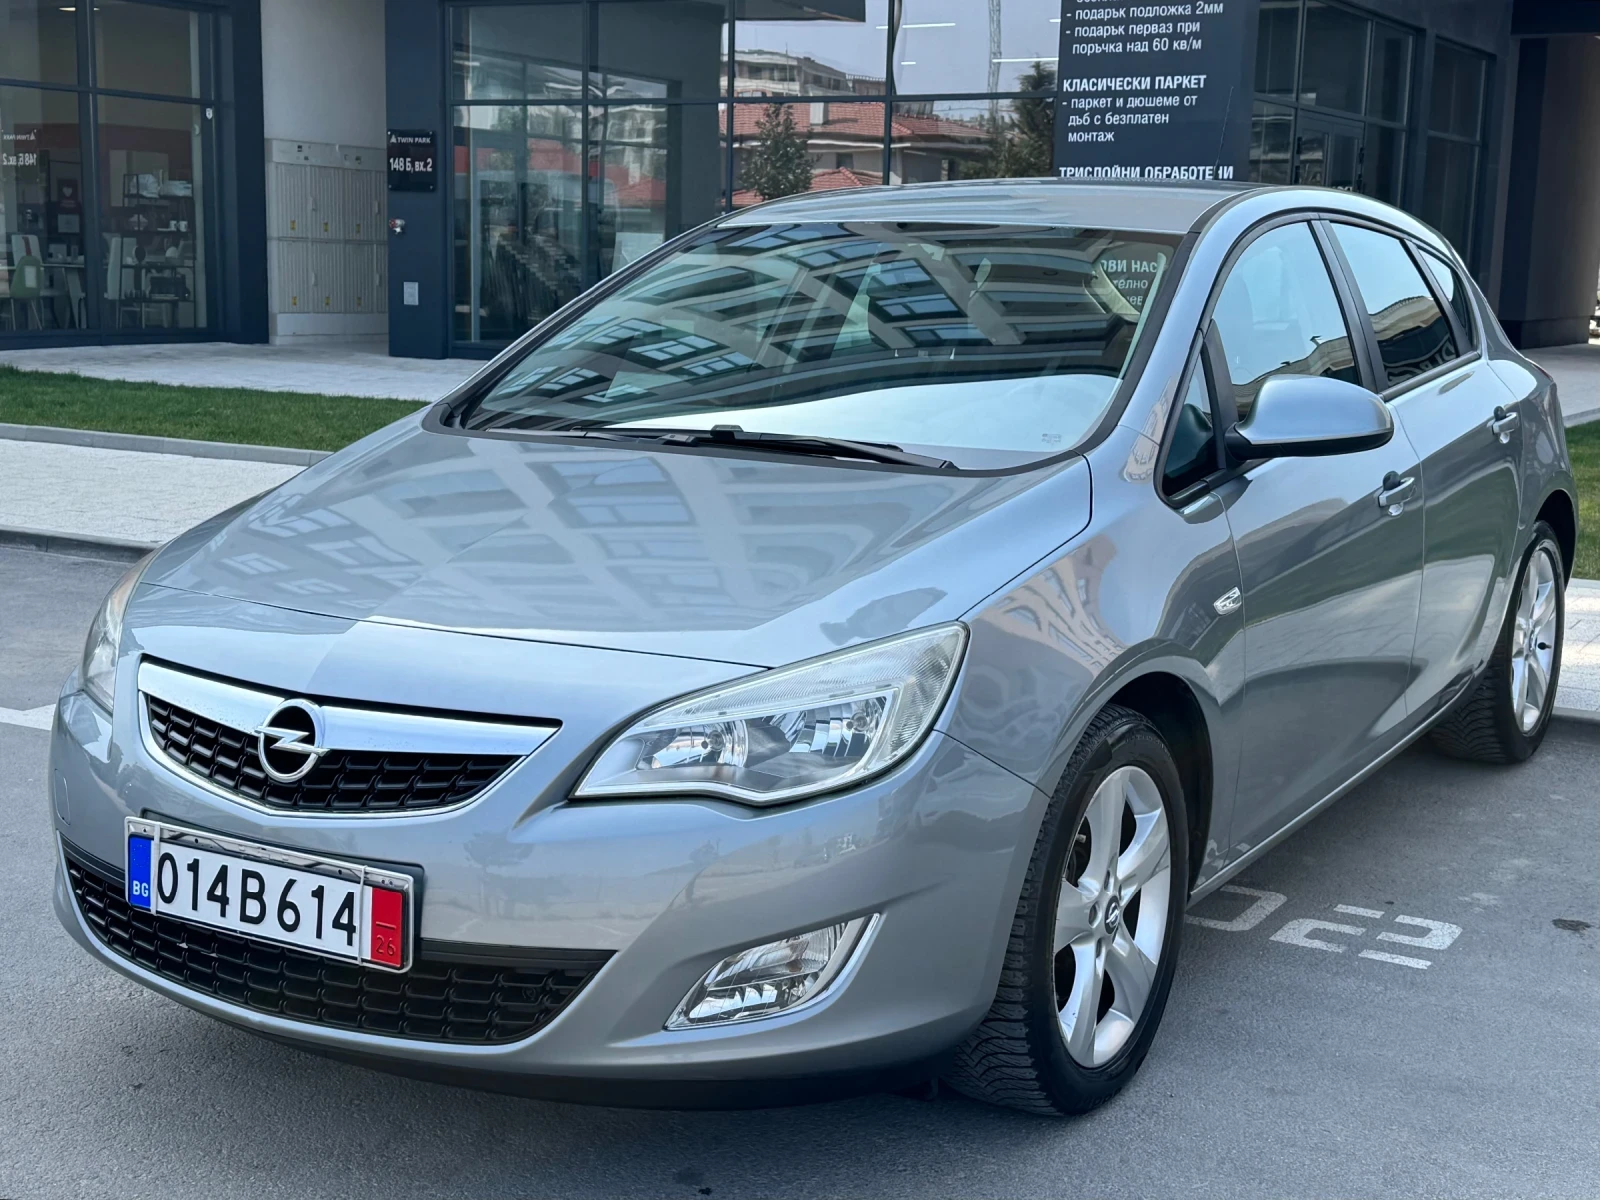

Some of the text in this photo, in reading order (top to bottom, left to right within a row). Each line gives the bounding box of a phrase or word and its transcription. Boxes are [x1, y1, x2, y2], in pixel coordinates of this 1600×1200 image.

[1075, 7, 1126, 21] подарък
[1129, 4, 1192, 18] подложка
[1195, 1, 1223, 15] 2мм
[1074, 24, 1125, 38] подарък
[1129, 22, 1173, 36] перваз
[1177, 21, 1200, 34] при
[1072, 36, 1202, 56] поръчка над 60 кв/м
[1063, 75, 1207, 92] КЛАСИЧЕСКИ ПАРКЕТ
[1071, 97, 1112, 110] паркет
[1116, 98, 1123, 107] и
[1126, 96, 1180, 108] дюшеме
[1183, 95, 1198, 106] от
[1068, 111, 1169, 127] дъб с безплатен
[1068, 131, 1115, 142] монтаж
[389, 157, 405, 171] 148
[1059, 164, 1141, 178] ТРИСЛОЙНИ
[132, 880, 149, 898] BG
[156, 851, 359, 947] 014B614
[376, 934, 397, 957] 26
